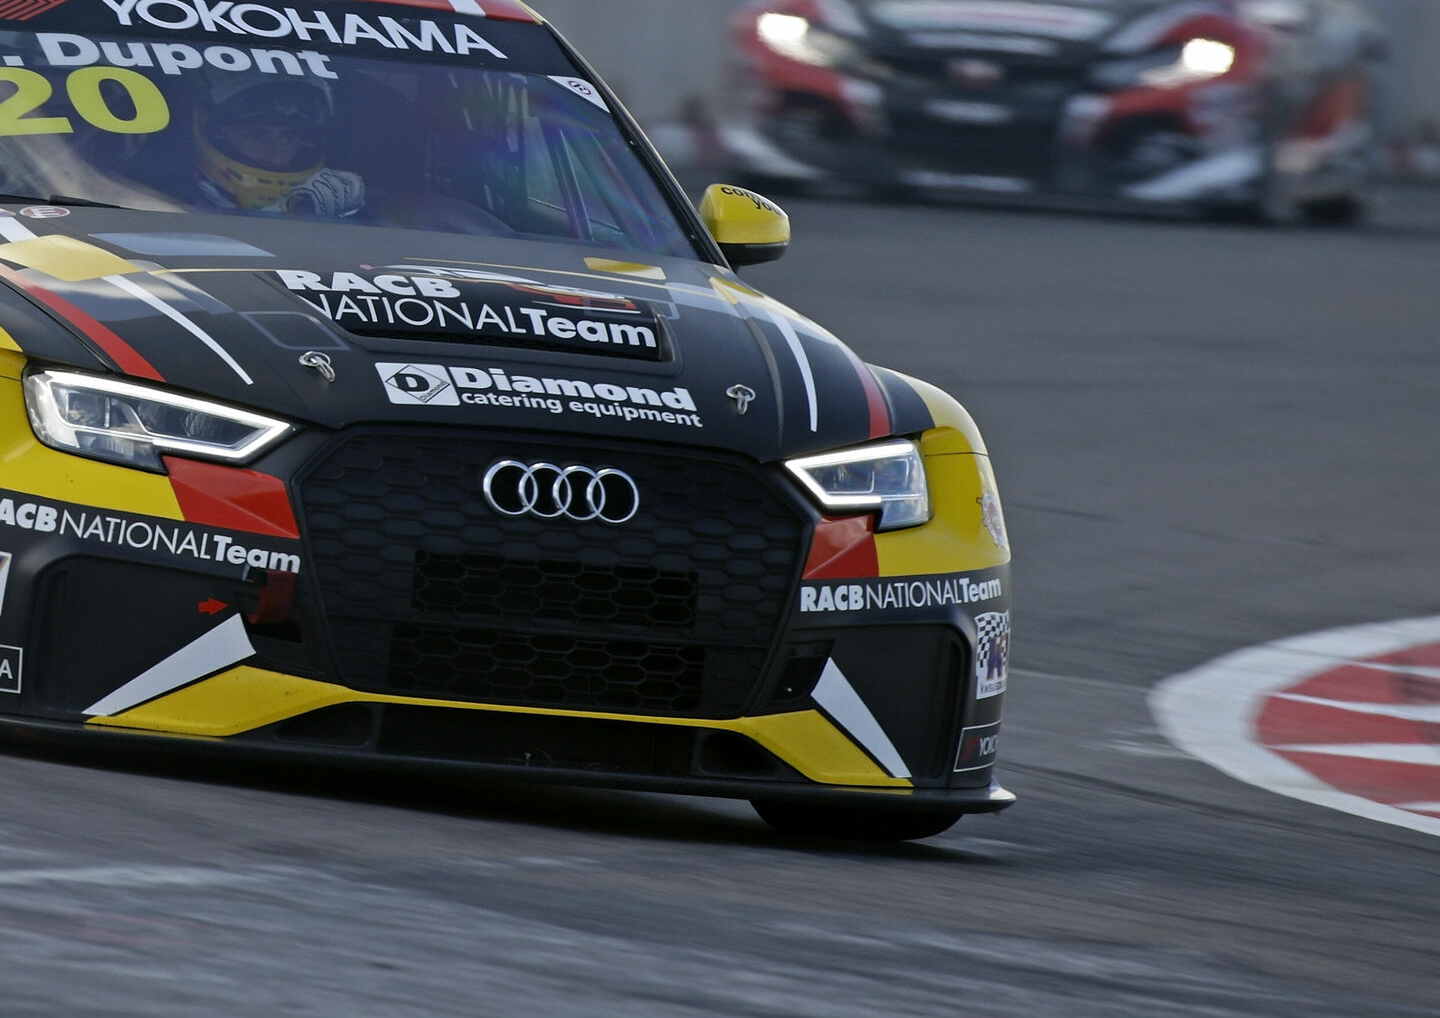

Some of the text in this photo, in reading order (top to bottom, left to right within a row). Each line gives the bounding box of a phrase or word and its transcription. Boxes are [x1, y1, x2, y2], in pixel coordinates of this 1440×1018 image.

[35, 31, 340, 81] Dupont
[275, 269, 461, 299] RACB
[447, 365, 698, 413] Diamond
[460, 390, 564, 414] catering
[568, 400, 704, 428] equipment
